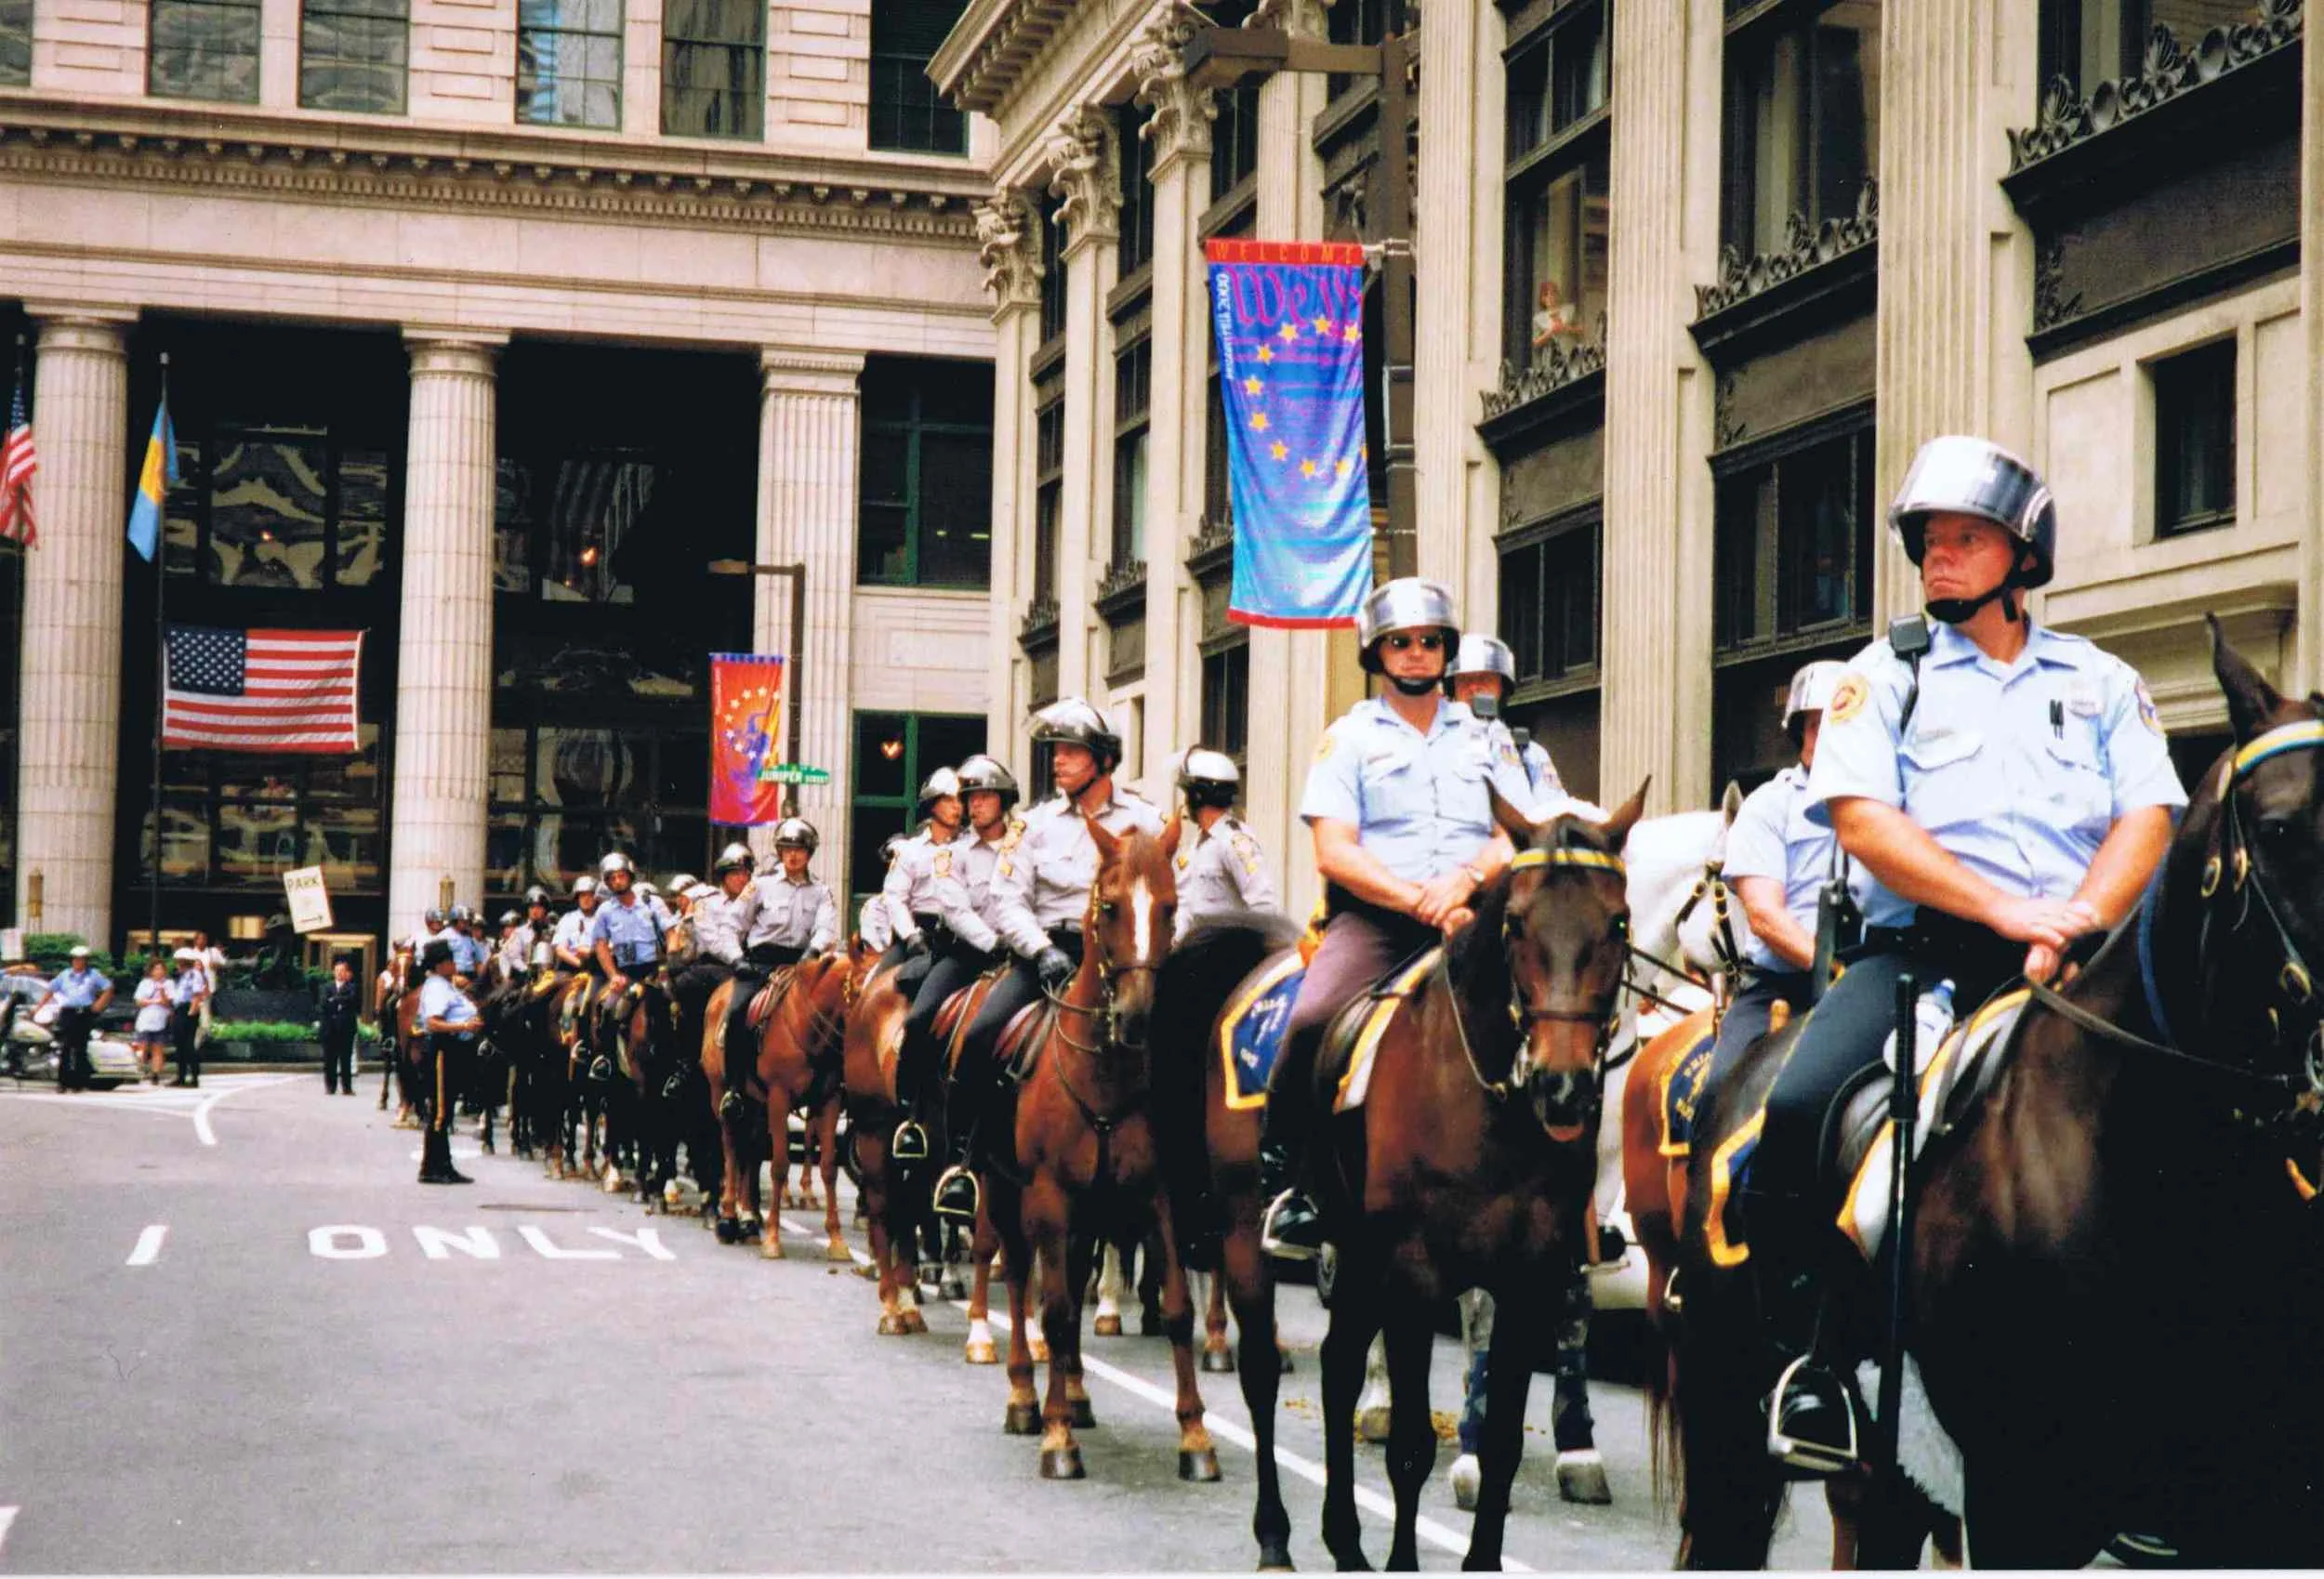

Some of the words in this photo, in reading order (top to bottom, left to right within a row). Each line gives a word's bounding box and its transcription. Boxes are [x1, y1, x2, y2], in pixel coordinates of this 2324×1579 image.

[1215, 243, 1352, 264] WELCOME
[760, 770, 802, 783] JUNIPER
[308, 1224, 678, 1260] ONLY
